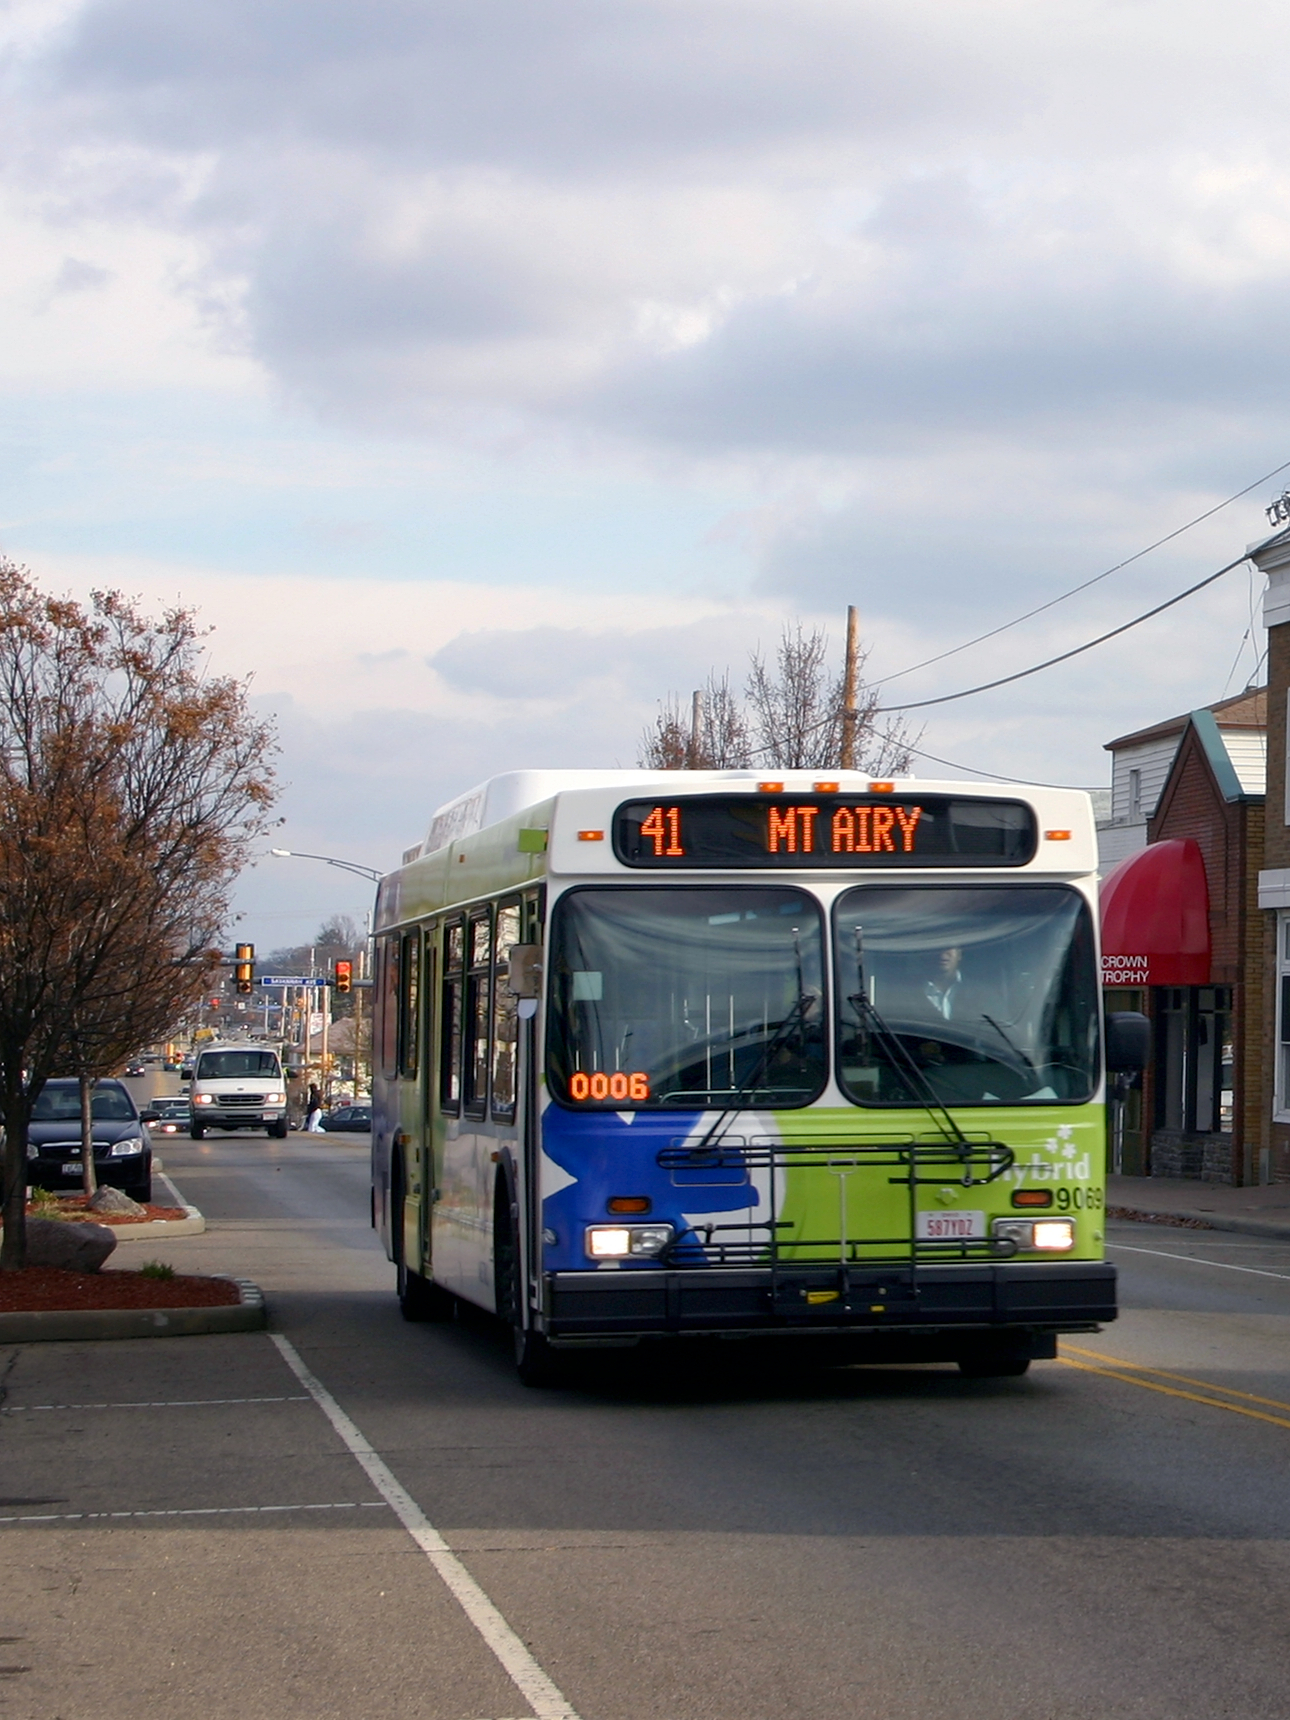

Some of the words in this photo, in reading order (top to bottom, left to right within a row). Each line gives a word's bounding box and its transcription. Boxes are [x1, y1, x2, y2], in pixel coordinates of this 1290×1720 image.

[640, 806, 684, 857] 41
[768, 806, 819, 853] MT
[832, 806, 922, 853] AIRY
[1101, 955, 1148, 968] CROWN
[1100, 970, 1149, 983] TROPHY
[570, 1071, 650, 1101] 0006
[1056, 1187, 1103, 1210] 9069
